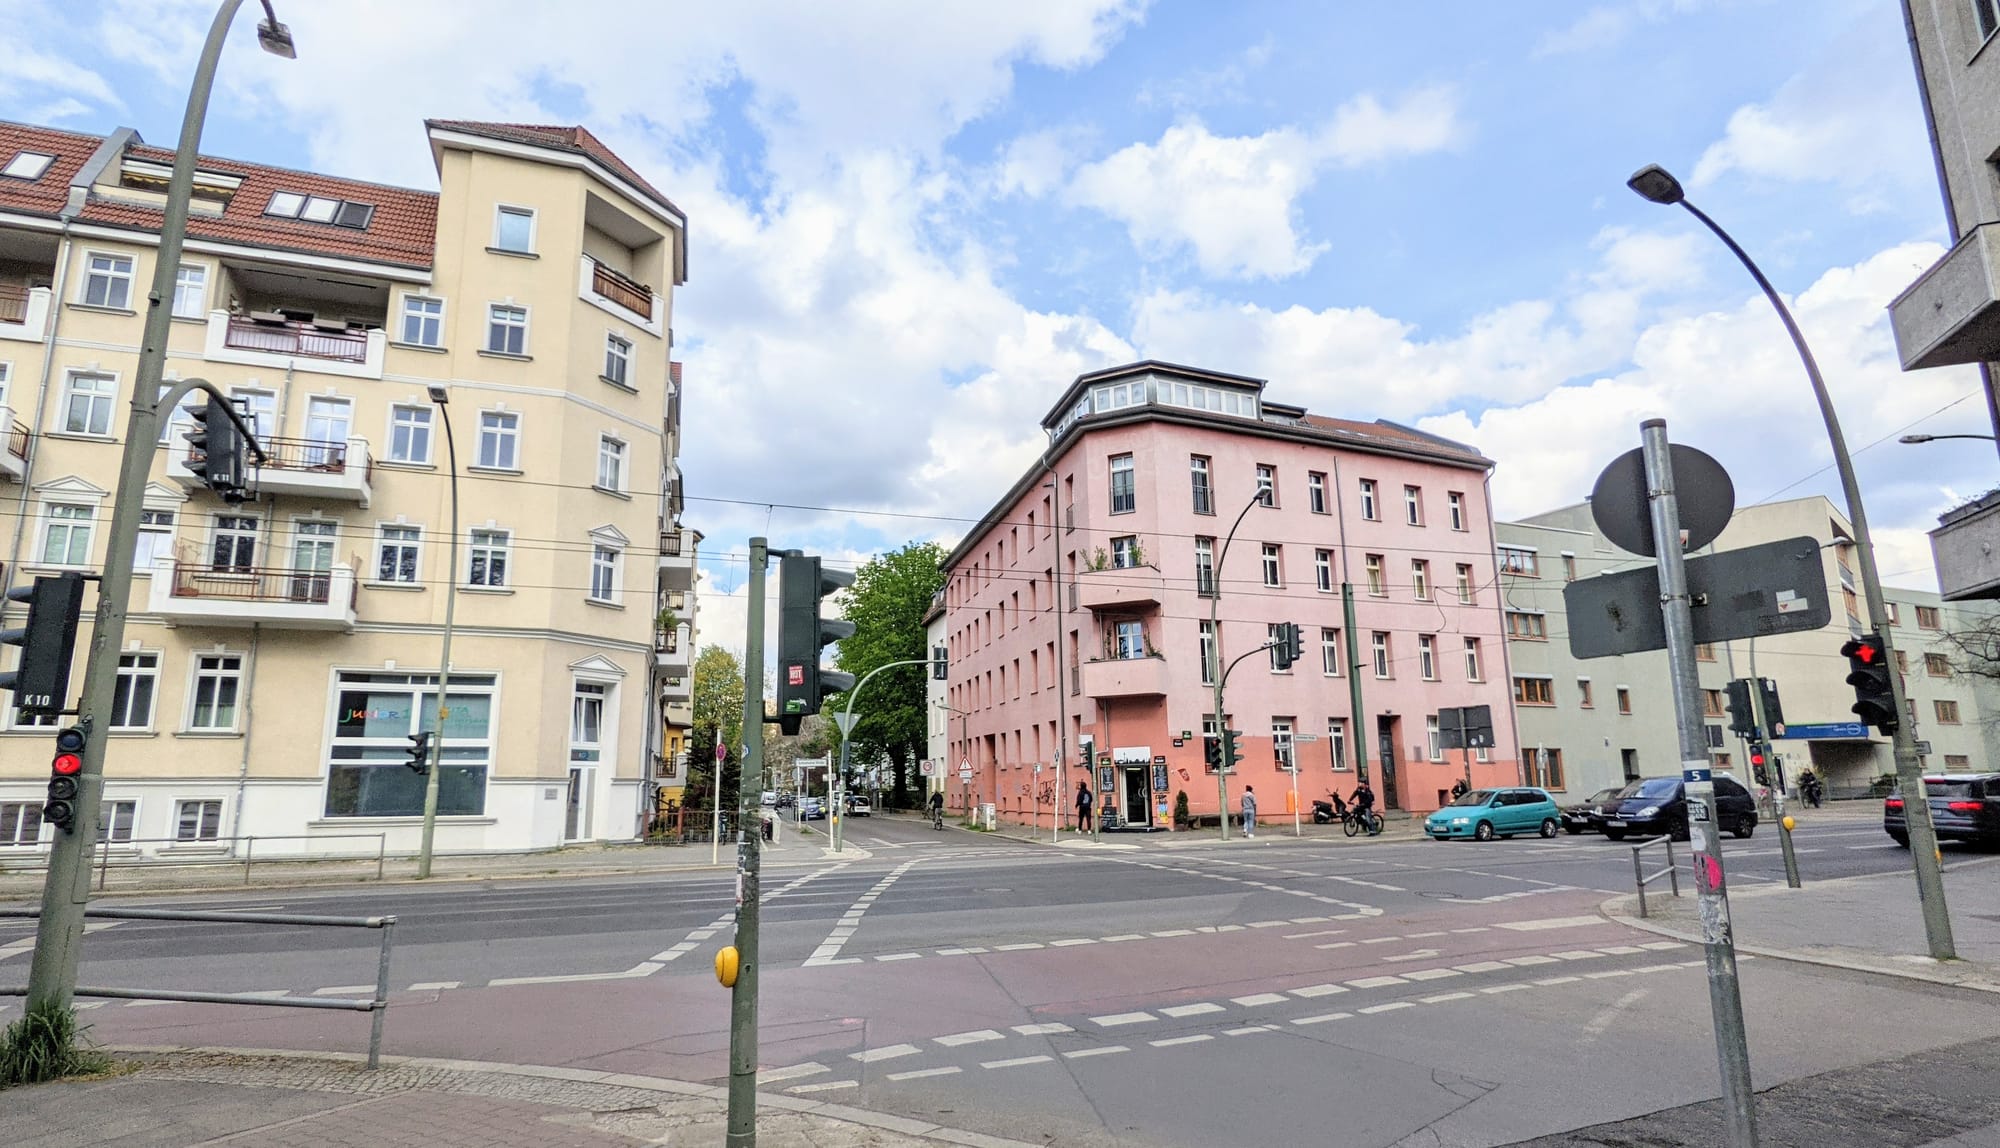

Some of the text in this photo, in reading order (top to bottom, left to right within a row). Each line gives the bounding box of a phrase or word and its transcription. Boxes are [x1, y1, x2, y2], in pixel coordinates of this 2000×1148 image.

[24, 694, 50, 706] K 10
[1691, 770, 1700, 781] 5
